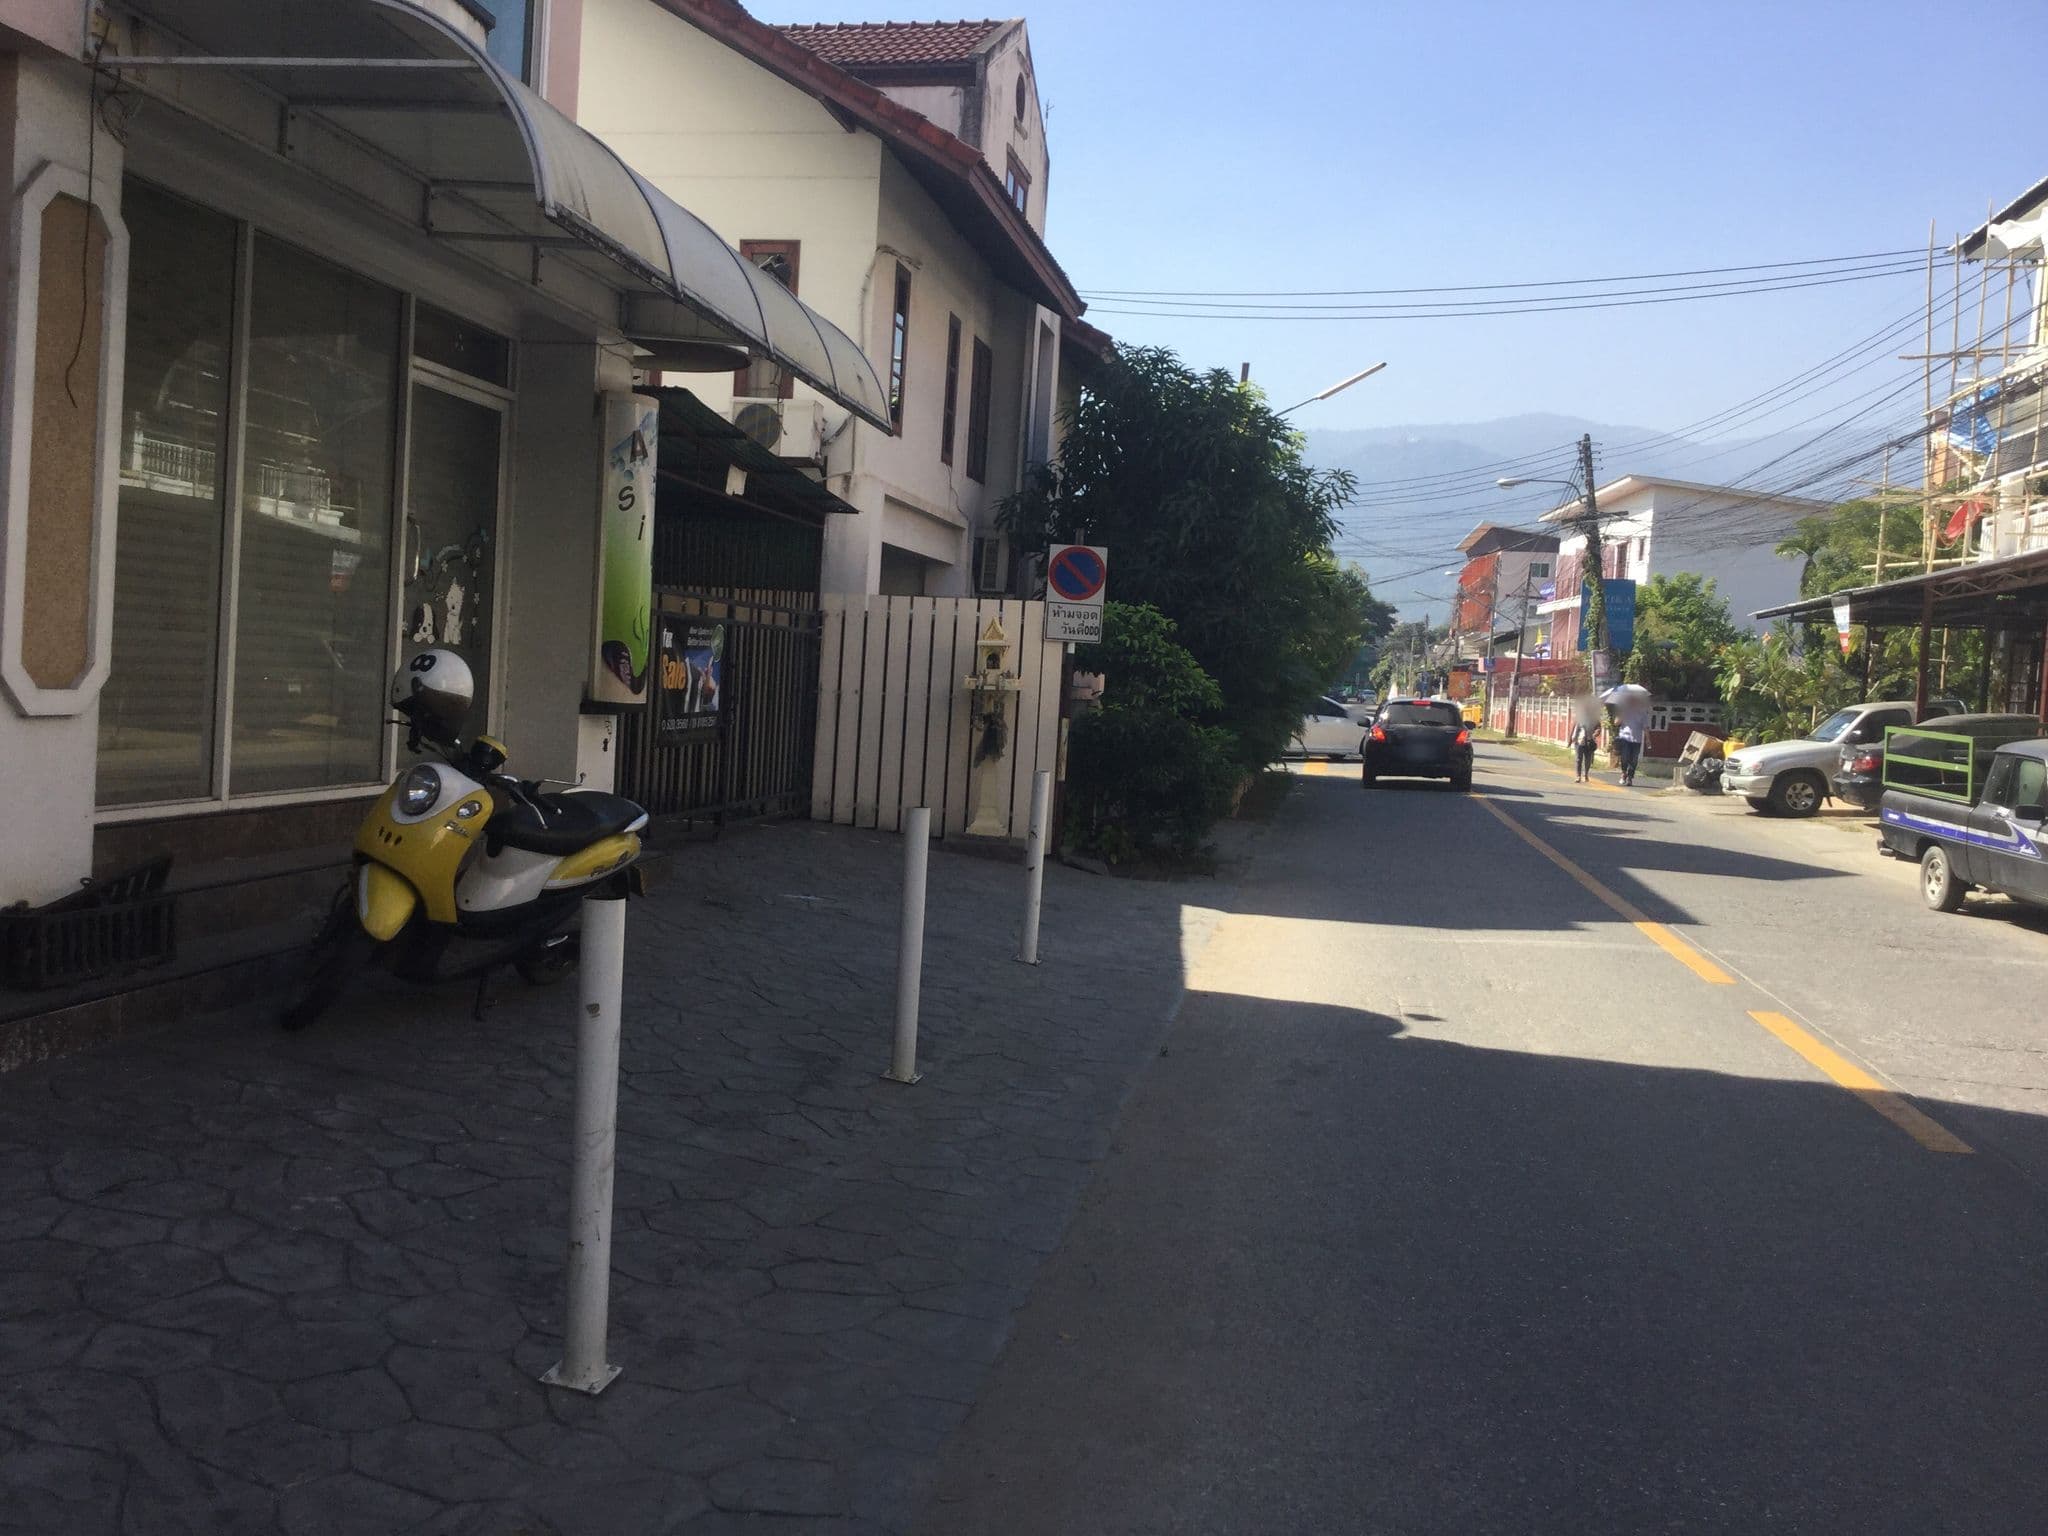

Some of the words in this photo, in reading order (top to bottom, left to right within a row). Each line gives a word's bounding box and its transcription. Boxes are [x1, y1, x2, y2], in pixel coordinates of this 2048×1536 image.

[1052, 605, 1098, 620] ห้ามจอด
[410, 654, 437, 672] 8
[662, 654, 686, 690] Sale
